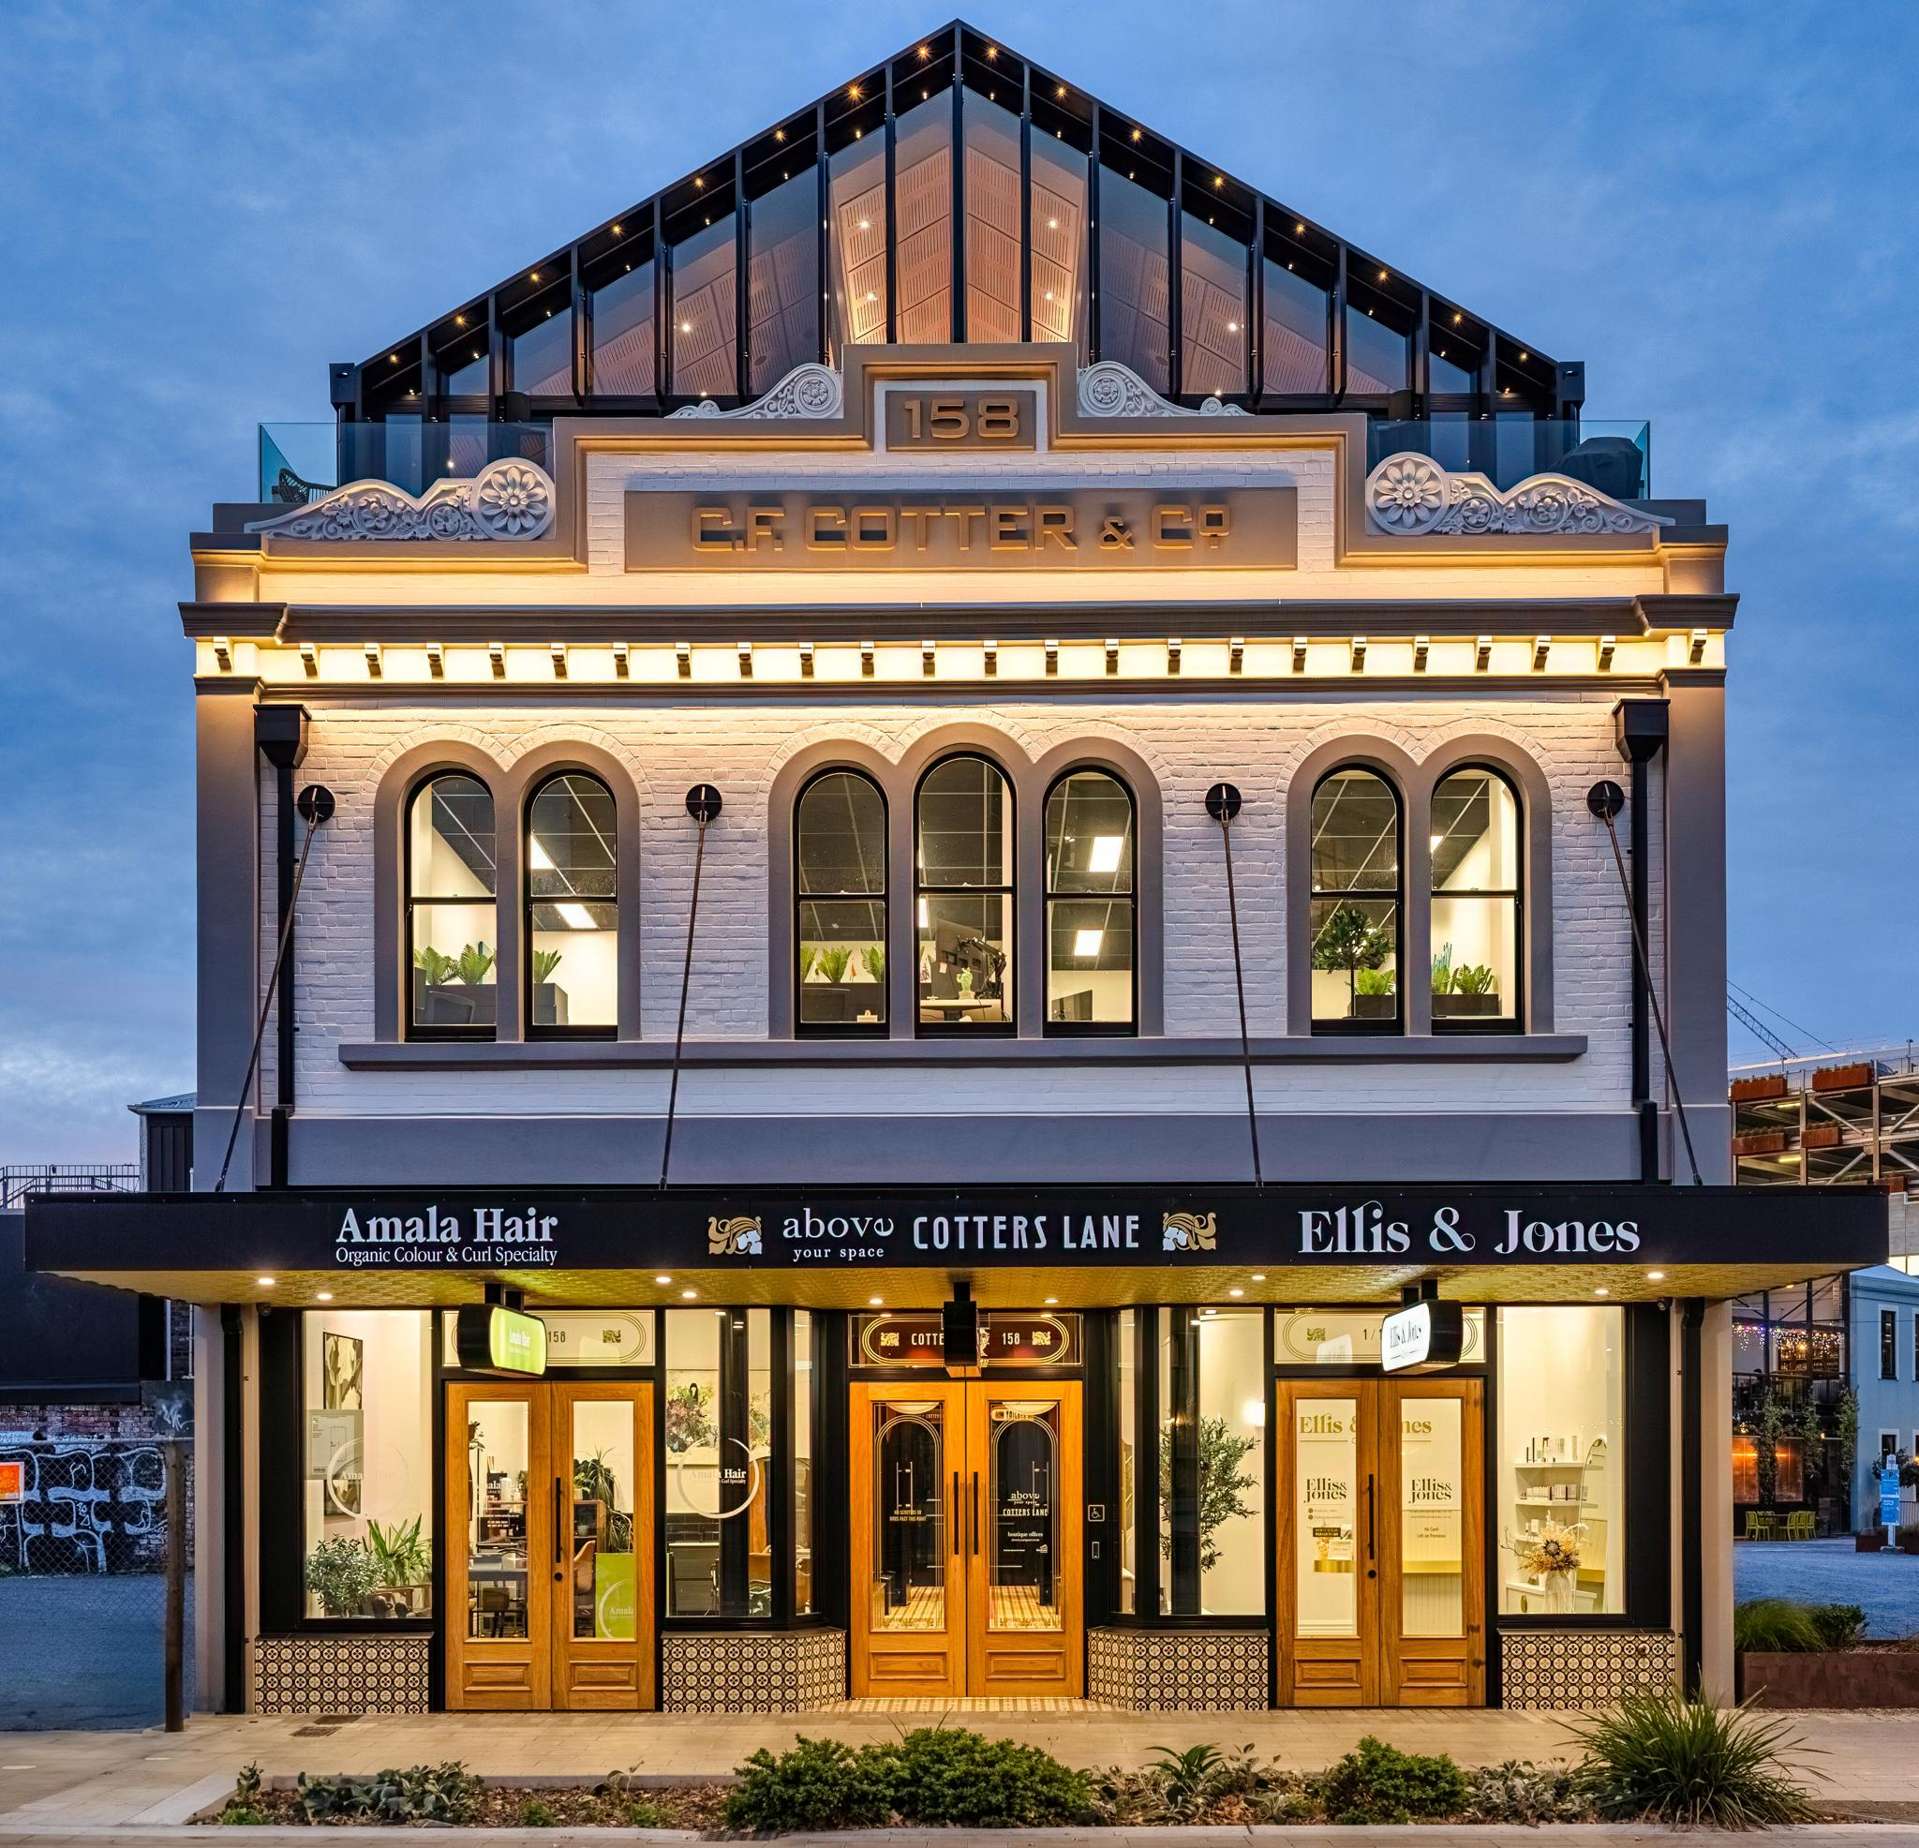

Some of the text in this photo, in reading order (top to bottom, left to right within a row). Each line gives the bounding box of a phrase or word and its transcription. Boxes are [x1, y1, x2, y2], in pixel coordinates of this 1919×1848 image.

[904, 399, 1019, 439] 158
[690, 506, 784, 552] C.F.
[804, 504, 1079, 551] COTTER
[1098, 515, 1134, 551] &
[335, 1206, 559, 1243] Amala Hair
[782, 1207, 894, 1239] above
[913, 1215, 1139, 1250] COTTERS LANE
[1297, 1201, 1640, 1254] Ellis & Jones
[335, 1246, 558, 1266] Organic Colour & Curl Specialty
[793, 1248, 884, 1263] your space
[548, 1330, 566, 1343] 158
[911, 1333, 944, 1346] COTTE
[1002, 1332, 1021, 1345] 158
[1299, 1412, 1343, 1434] Ellis
[1402, 1420, 1432, 1434] nes
[724, 1468, 747, 1479] Hair
[1002, 1508, 1049, 1517] COTTERS LANE
